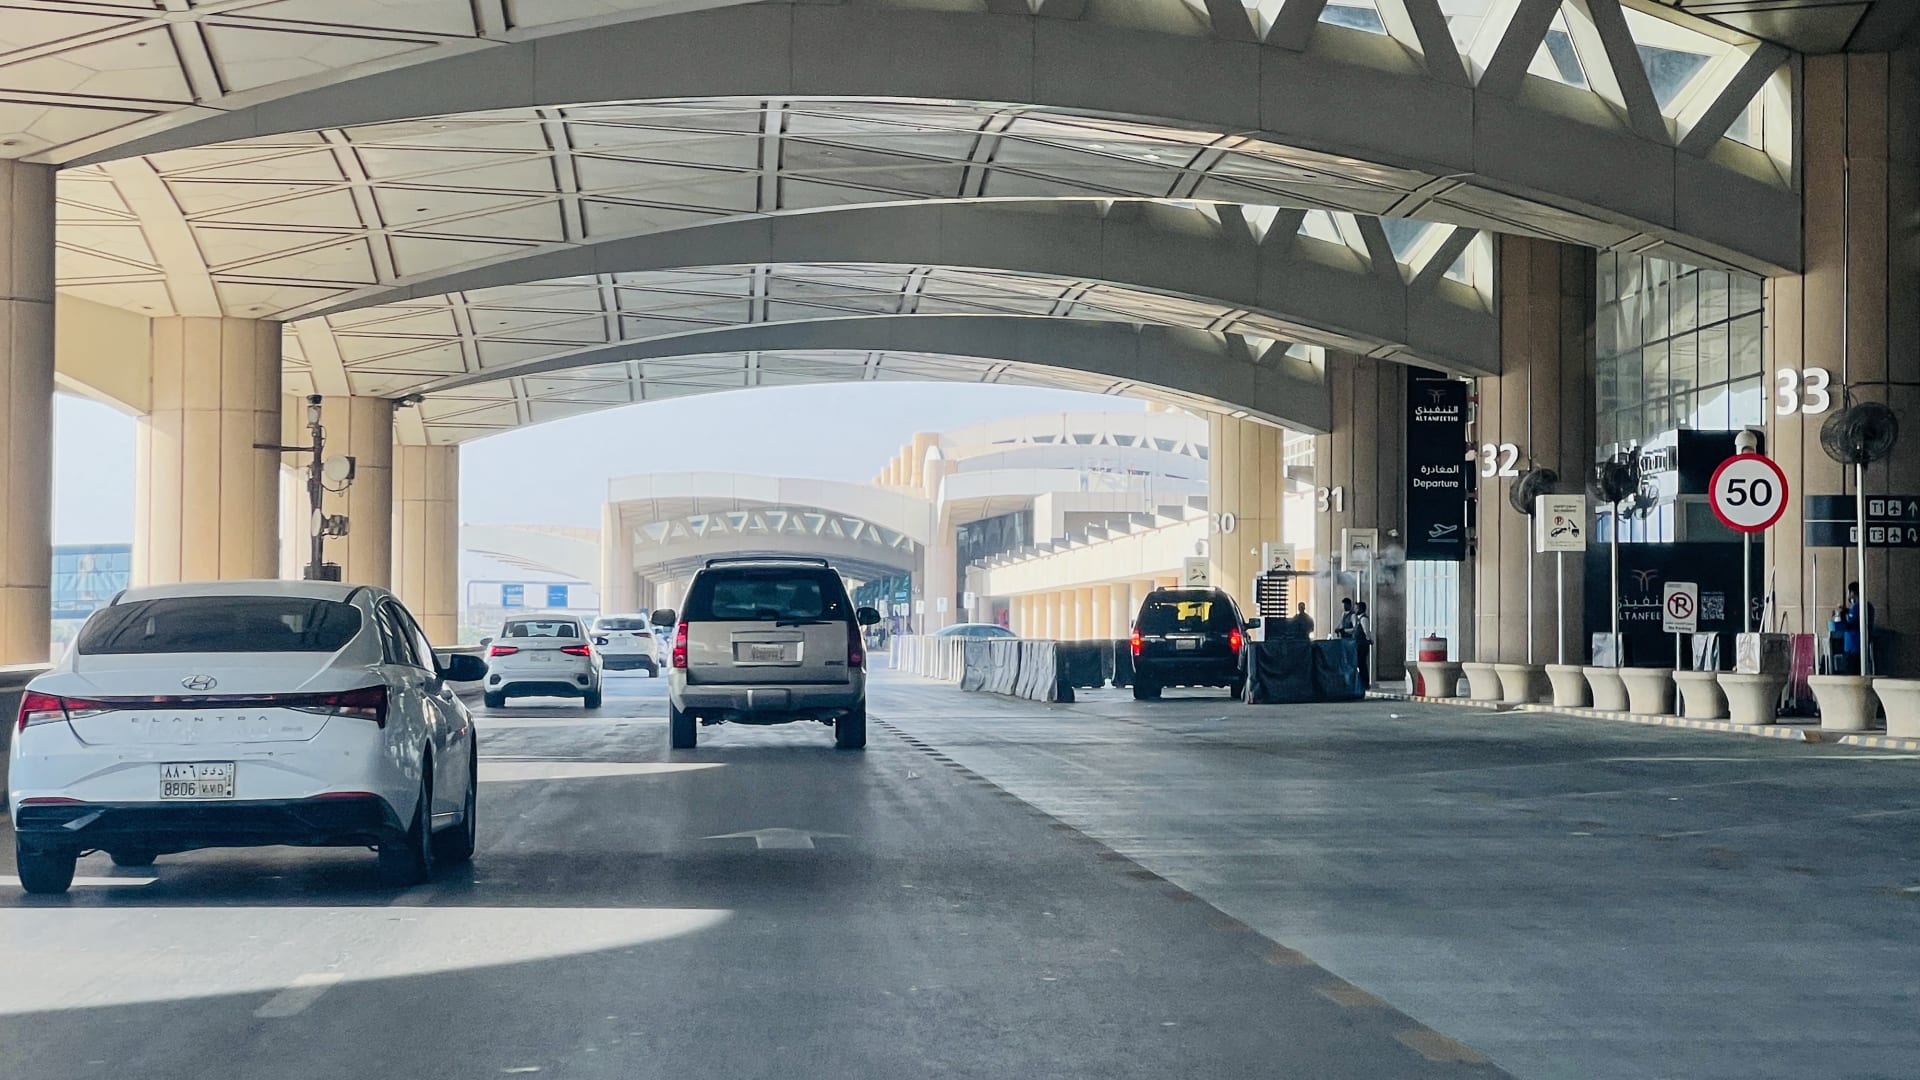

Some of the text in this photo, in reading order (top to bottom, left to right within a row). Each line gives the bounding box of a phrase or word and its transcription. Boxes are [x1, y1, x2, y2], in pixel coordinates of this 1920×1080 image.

[1776, 367, 1830, 416] 33
[1481, 443, 1519, 478] 32
[1421, 464, 1459, 476] المغادرة
[1413, 478, 1459, 490] Departure
[1317, 485, 1344, 513] 31
[1725, 478, 1773, 507] 50
[1871, 502, 1884, 514] T1
[1210, 511, 1236, 535] 30
[1870, 529, 1884, 541] T3
[131, 715, 269, 724] ELANTRA
[164, 782, 196, 797] 8806
